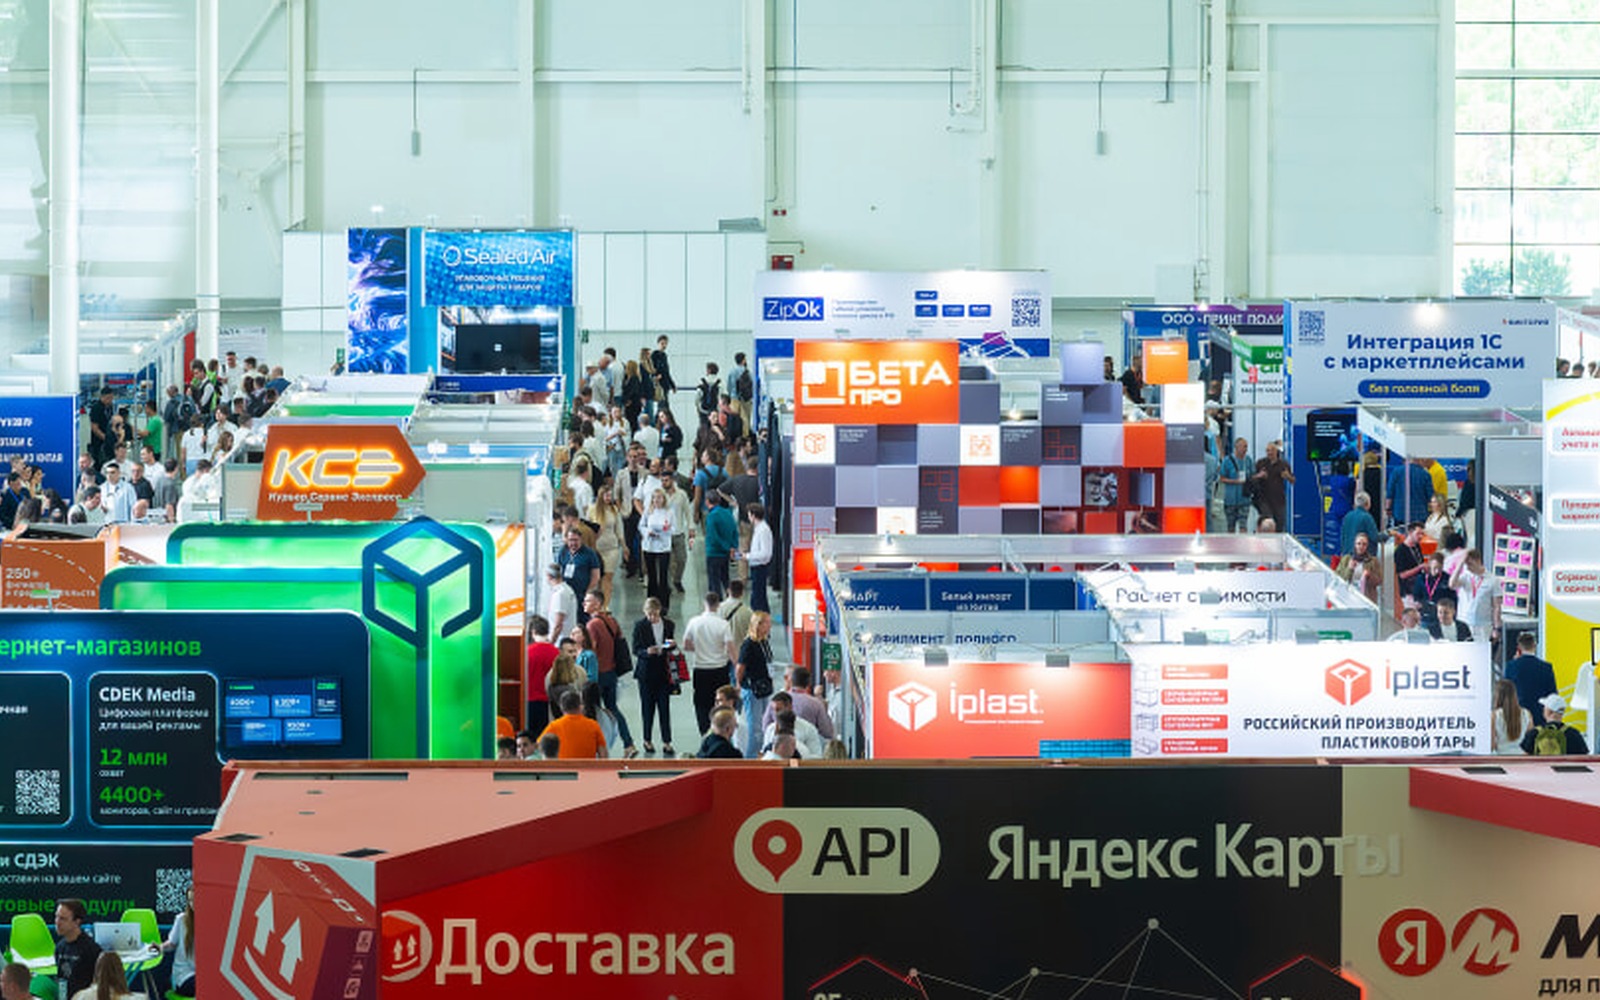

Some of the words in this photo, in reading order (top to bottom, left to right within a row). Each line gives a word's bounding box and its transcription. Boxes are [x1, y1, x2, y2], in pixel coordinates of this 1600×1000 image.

[464, 248, 528, 265] Sealed
[530, 248, 557, 265] Air
[766, 299, 821, 319] ZipOk
[1161, 313, 1195, 325] ООО
[1347, 334, 1474, 351] Интеграция
[1480, 334, 1503, 350] 1С
[1324, 357, 1336, 369] с
[1341, 354, 1525, 373] маркетплейсами
[849, 360, 953, 386] БЕТА
[849, 388, 902, 405] ПРО
[1368, 383, 1389, 394] без
[1391, 383, 1448, 394] головной
[1187, 591, 1286, 603] симости
[1385, 658, 1471, 696] iplast
[99, 687, 143, 702] CDEK
[147, 686, 196, 702] Media
[98, 708, 151, 719] Цифровая
[152, 708, 209, 719] платформа
[98, 722, 118, 731] для
[120, 720, 153, 730] вашей
[156, 722, 201, 731] рекламы
[1243, 714, 1342, 730] РОССИЙСКИЙ
[1345, 716, 1476, 731] ПРОИЗВОДИТЕЛЬ
[1322, 733, 1430, 749] ПЛАСТИКОВОЙ
[1433, 735, 1475, 749] ТАРЫ
[100, 749, 122, 766] 12
[128, 752, 168, 766] млн
[99, 786, 165, 803] 4400+
[812, 826, 911, 877] API
[987, 825, 1198, 888] Яндекс
[1214, 822, 1402, 888] Карты
[14, 853, 60, 870] СДЭК
[57, 875, 90, 884] вашем
[92, 873, 122, 883] сайте
[434, 918, 736, 985] Доставка
[1538, 978, 1581, 997] для
